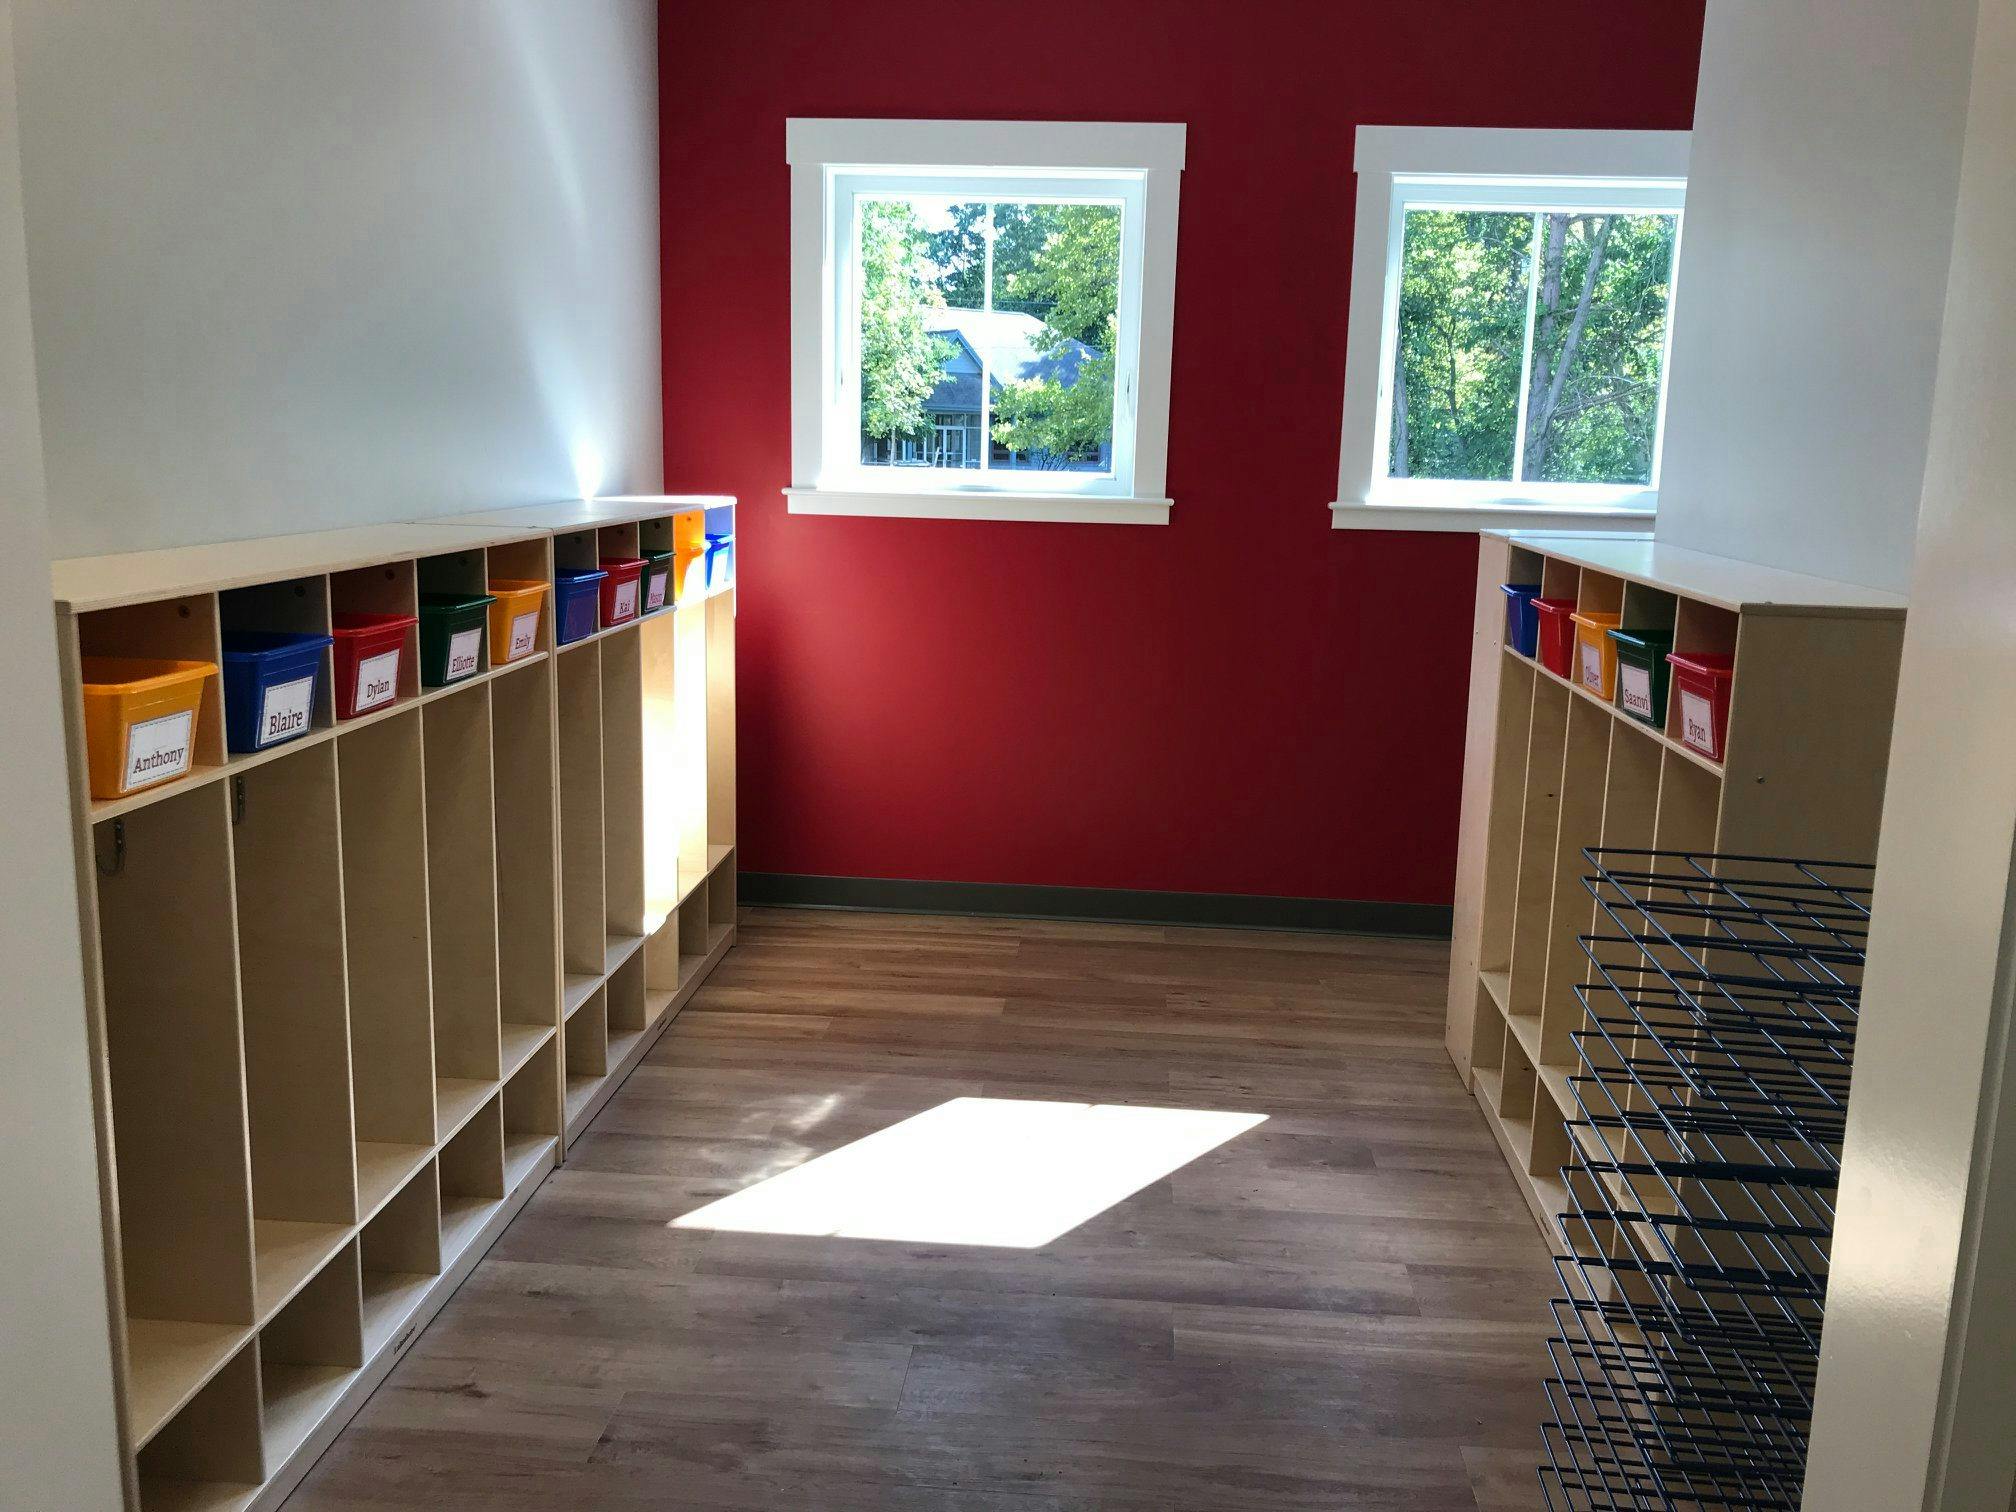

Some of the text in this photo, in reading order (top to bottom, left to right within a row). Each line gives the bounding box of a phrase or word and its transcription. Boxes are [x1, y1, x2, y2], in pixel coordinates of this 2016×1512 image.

[515, 633, 531, 649] Emily
[451, 655, 475, 674] Elliotte
[366, 679, 390, 700] Dylan
[1624, 688, 1649, 712] Saanvi
[268, 708, 303, 736] Blaire
[1688, 718, 1706, 742] Ryan
[133, 746, 184, 774] Anthony
